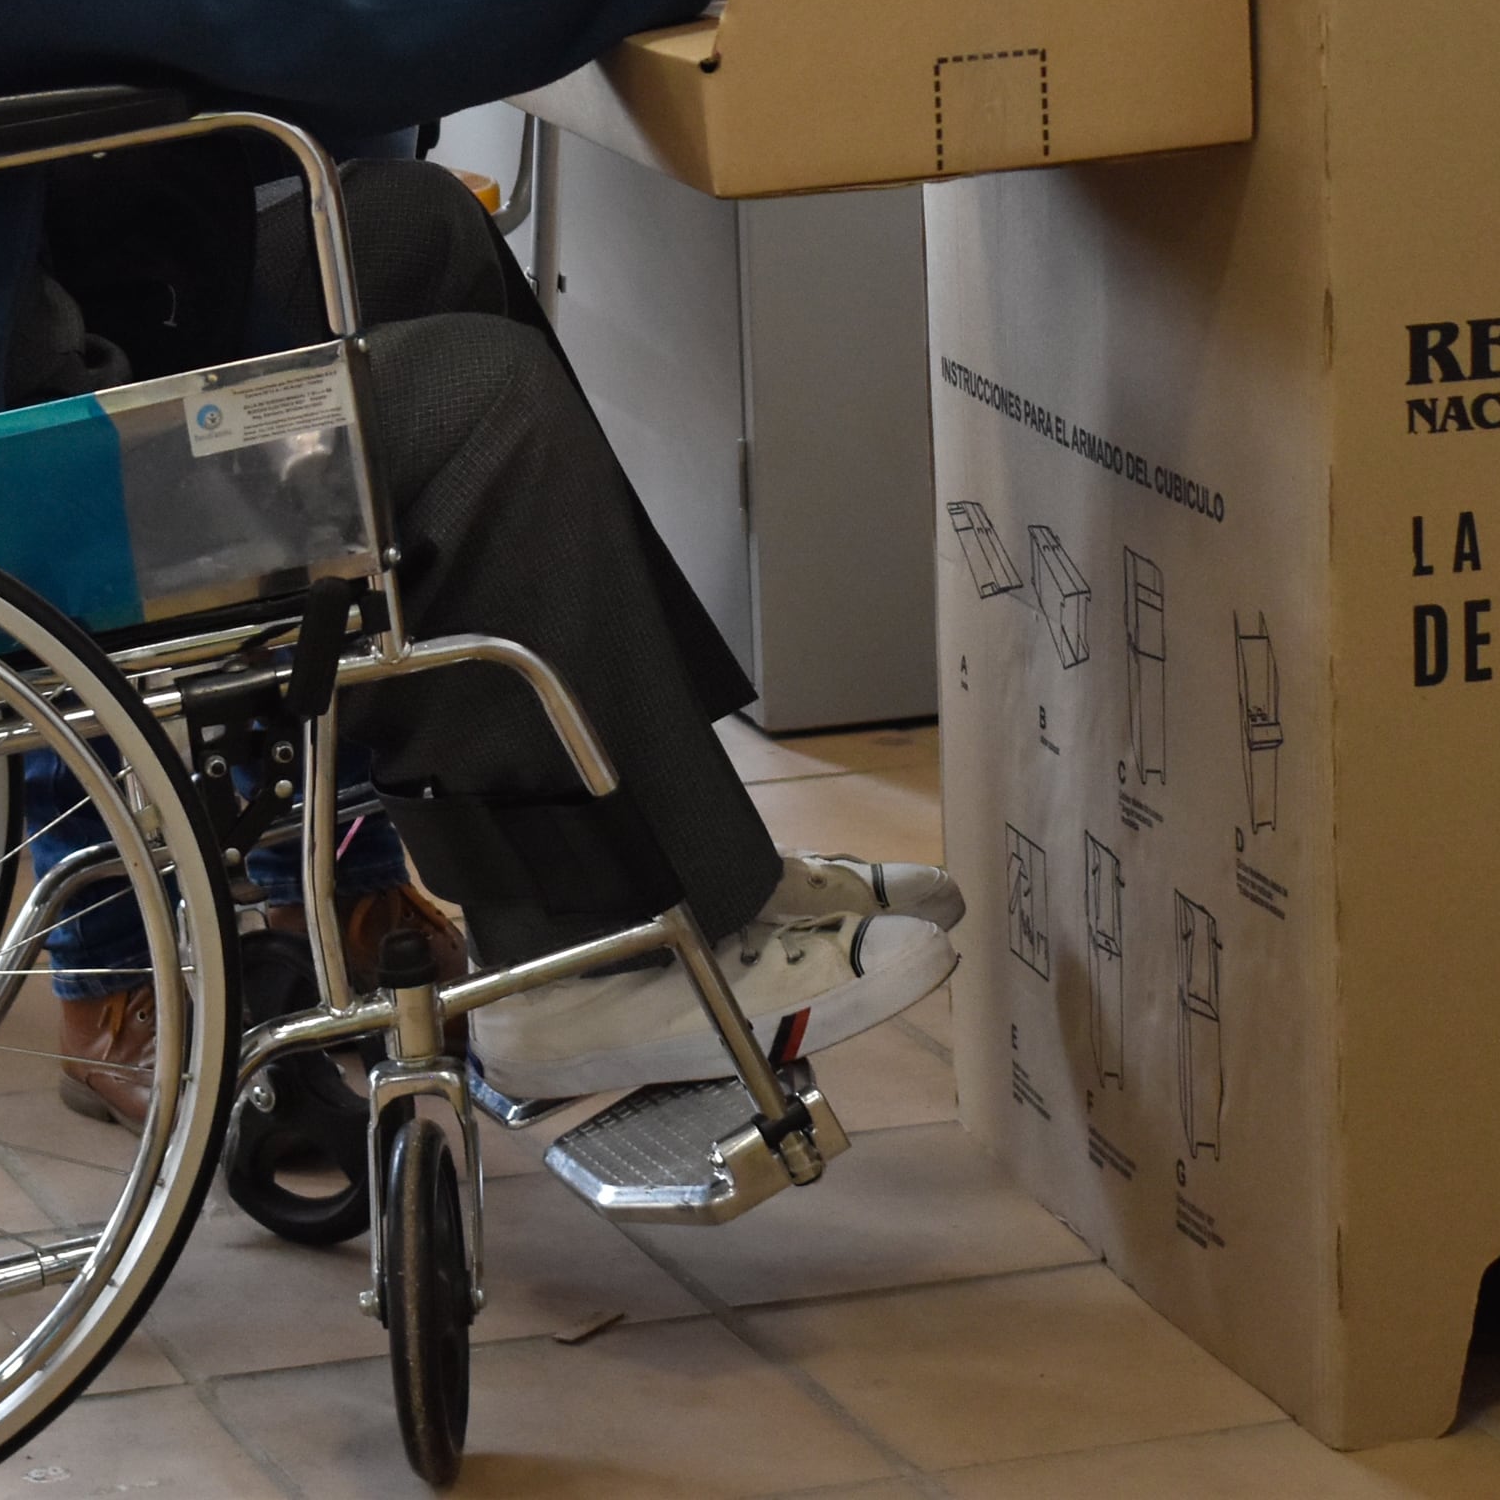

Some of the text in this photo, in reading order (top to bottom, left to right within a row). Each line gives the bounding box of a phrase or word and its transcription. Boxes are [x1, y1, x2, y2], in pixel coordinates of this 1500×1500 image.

[941, 355, 1225, 523] INSTRUCCIONES PARA EL ARMADO DEL CUBICULO
[1412, 510, 1482, 577] LA
[1039, 705, 1047, 730] B
[1117, 760, 1126, 784] C
[1235, 826, 1244, 852] D
[1176, 1159, 1186, 1187] G
